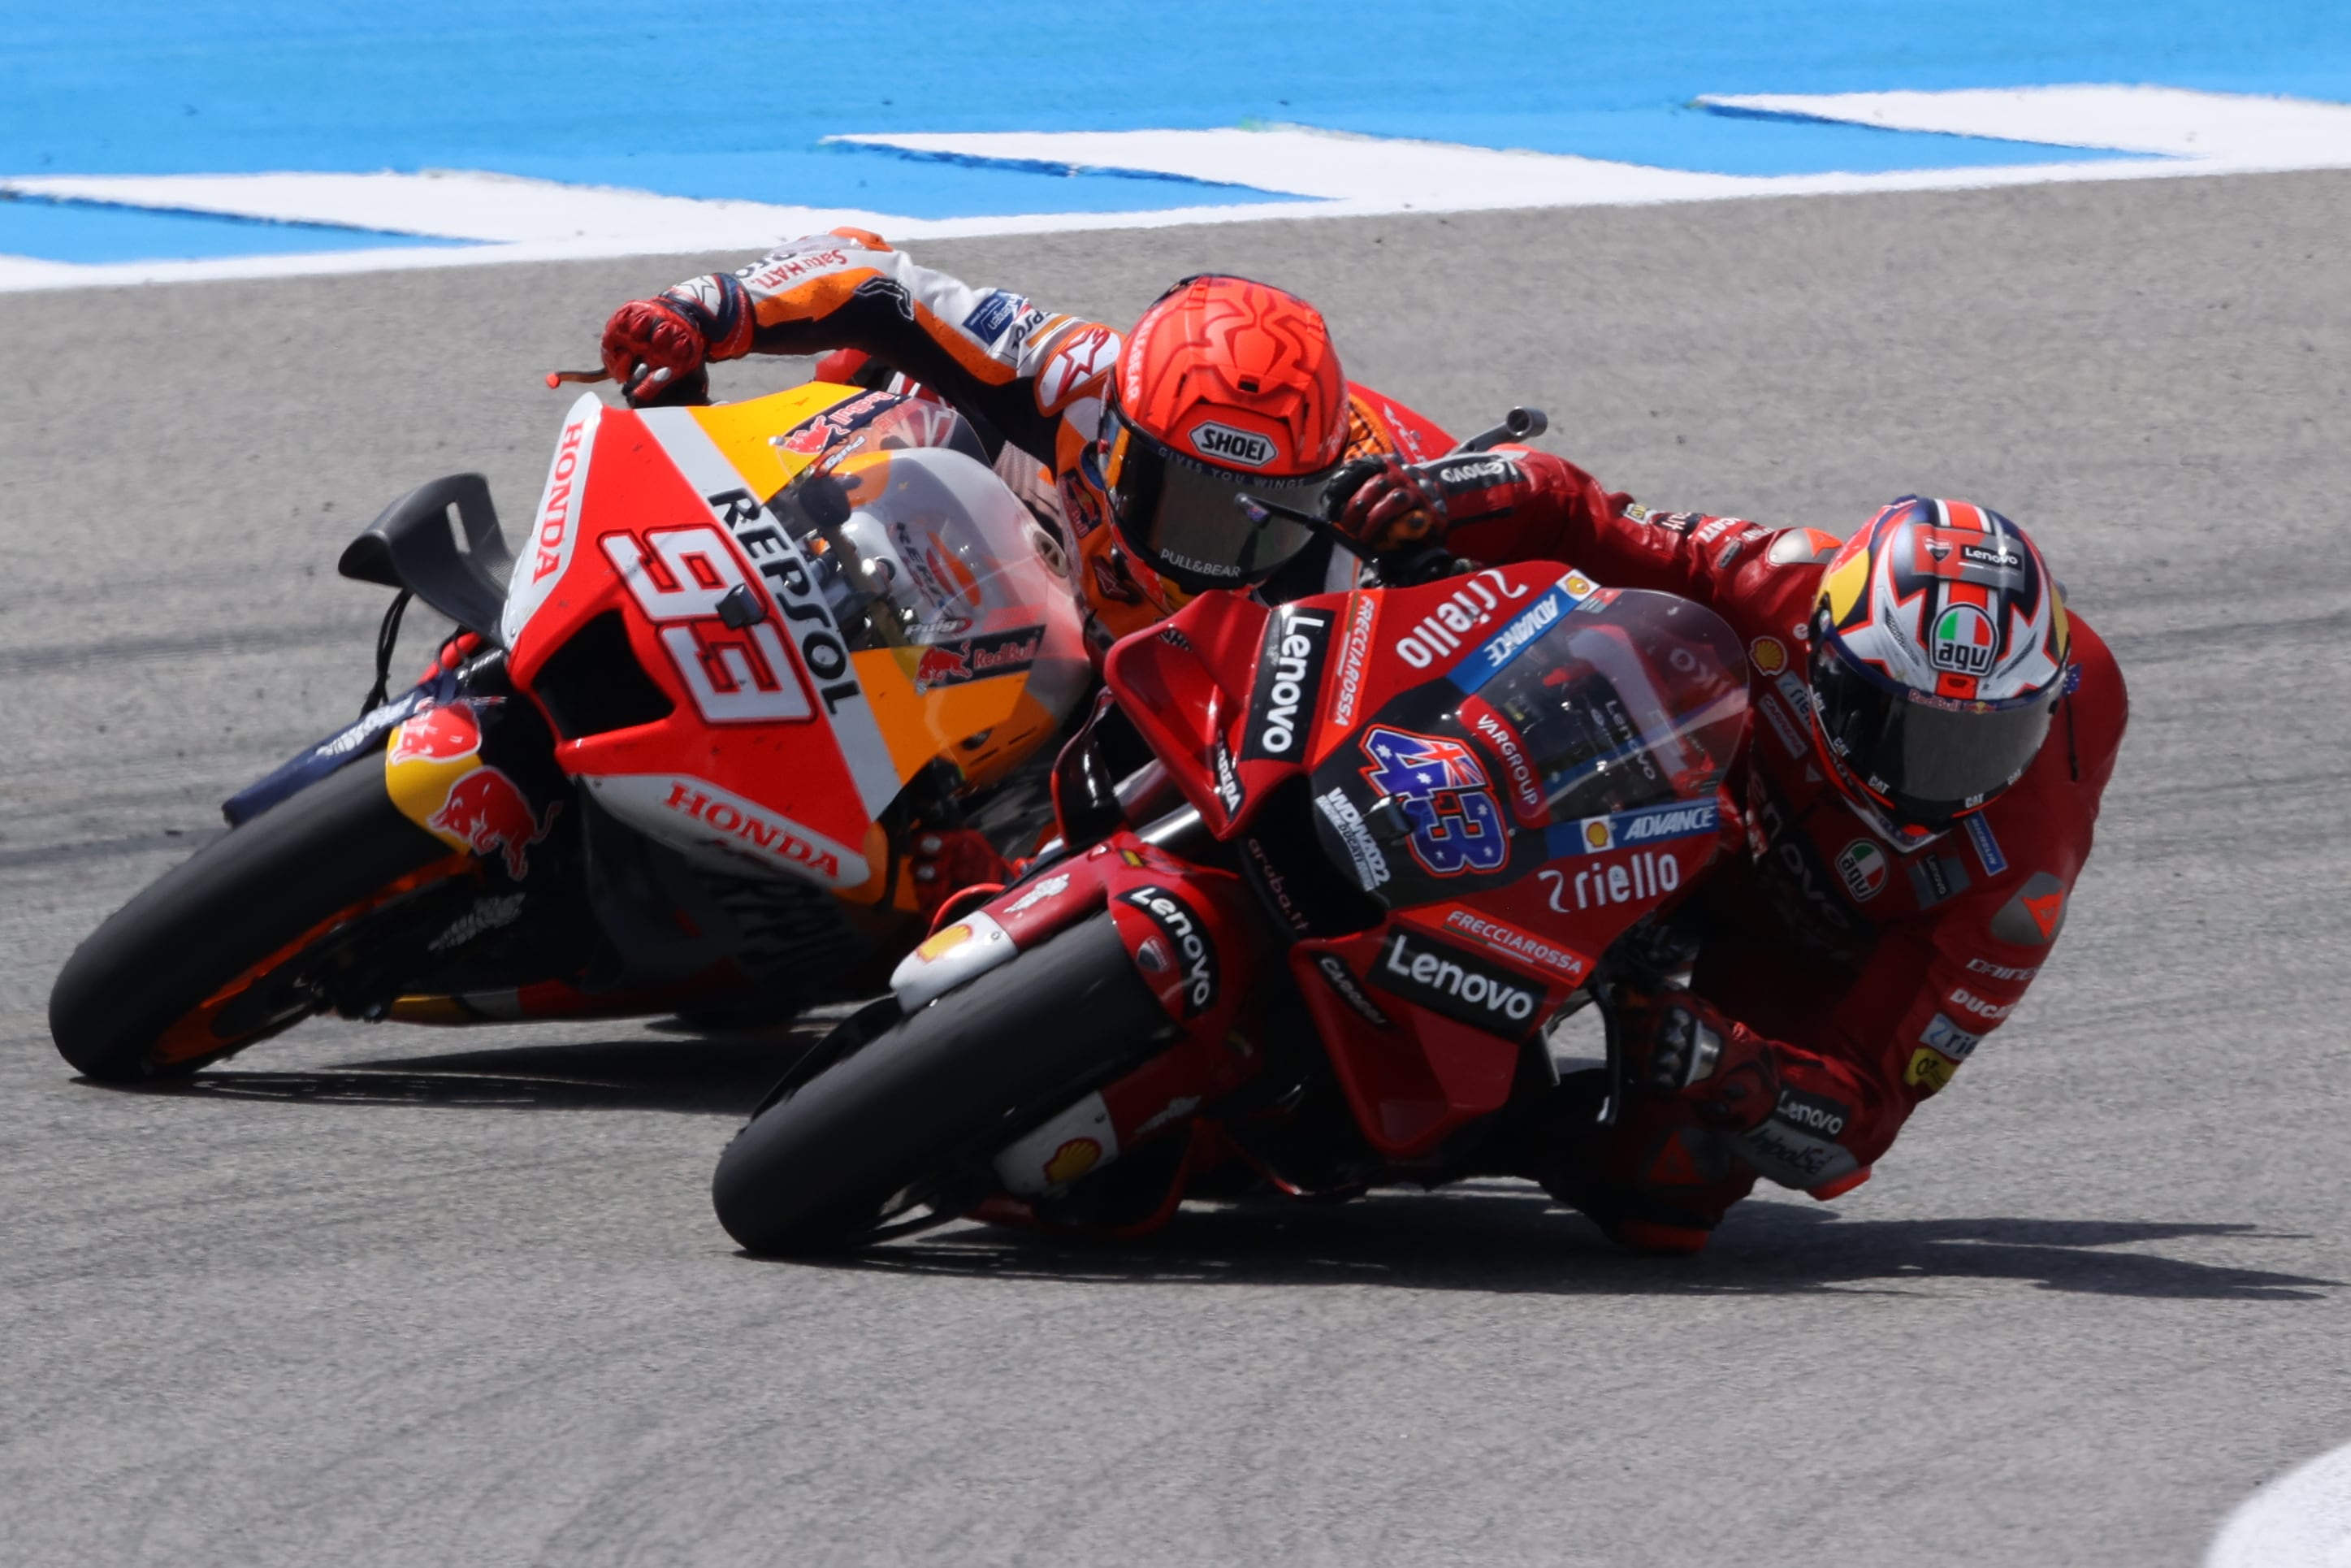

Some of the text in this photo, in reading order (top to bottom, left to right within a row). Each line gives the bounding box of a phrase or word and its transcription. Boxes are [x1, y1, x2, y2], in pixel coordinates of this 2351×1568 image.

[802, 249, 848, 271] Satu
[825, 435, 866, 469] Puig
[1158, 448, 1203, 474] GIVES
[1211, 468, 1245, 484] YOU
[1201, 427, 1266, 461] SHOEI
[1440, 458, 1519, 483] Lenovo
[533, 418, 586, 585] HONDA
[1160, 548, 1242, 578] PULL&BEAR
[1964, 546, 2019, 565] Lenovo
[600, 526, 816, 722] 93
[707, 487, 861, 716] REPSOL
[903, 617, 959, 637] Puig
[1483, 593, 1560, 668] ADVANCE
[1334, 595, 1375, 727] FRECCIAROSSA
[1938, 642, 1989, 671] agv
[1262, 615, 1325, 753] Lenovo
[1477, 713, 1539, 808] VARGROUP
[1604, 699, 1656, 781] Lenovo
[1833, 737, 1852, 758] CAT
[1361, 725, 1509, 876] 43
[1868, 776, 1891, 795] CAT
[1964, 793, 1985, 809] CAT
[662, 782, 841, 881] HONDA
[1327, 786, 1391, 887] WDW2022
[1622, 805, 1715, 842] ADVANCE
[1247, 837, 1308, 931] aruba.it
[1840, 854, 1870, 894] agv
[1925, 854, 1948, 895] Lenovo
[1129, 884, 1212, 1007] Lenovo
[1447, 910, 1582, 975] FRECCIAROSSA
[1386, 933, 1534, 1021] Lenovo
[1776, 1089, 1843, 1136] Lenovo
